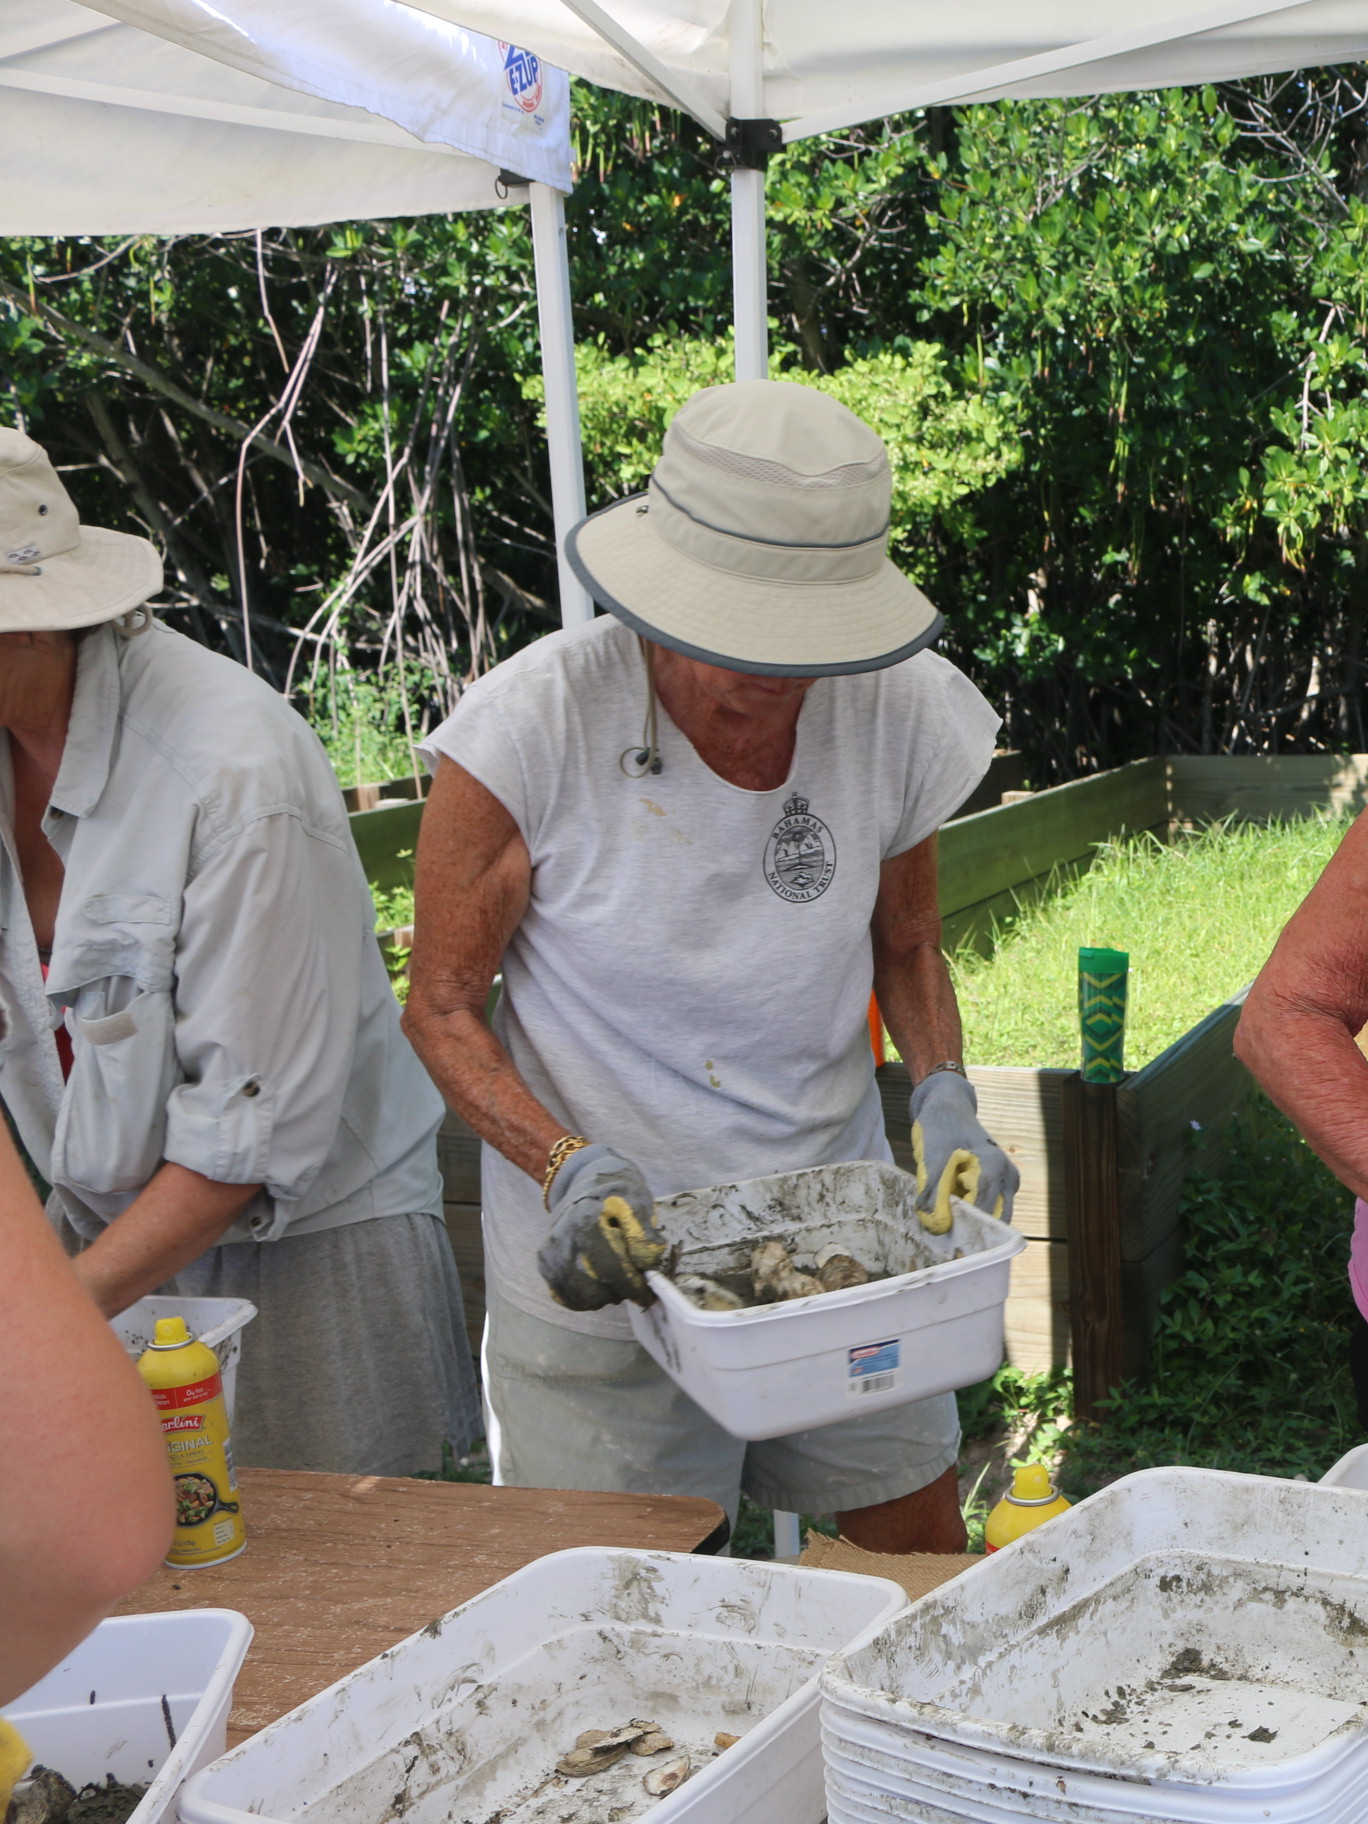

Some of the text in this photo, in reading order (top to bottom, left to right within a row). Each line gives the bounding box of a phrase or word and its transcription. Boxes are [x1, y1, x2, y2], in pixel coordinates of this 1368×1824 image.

[772, 817, 824, 840] BAHAMAS
[768, 861, 833, 900] NATIONAL TRUST
[162, 1416, 199, 1430] arlini
[168, 1435, 213, 1453] IGINAL
